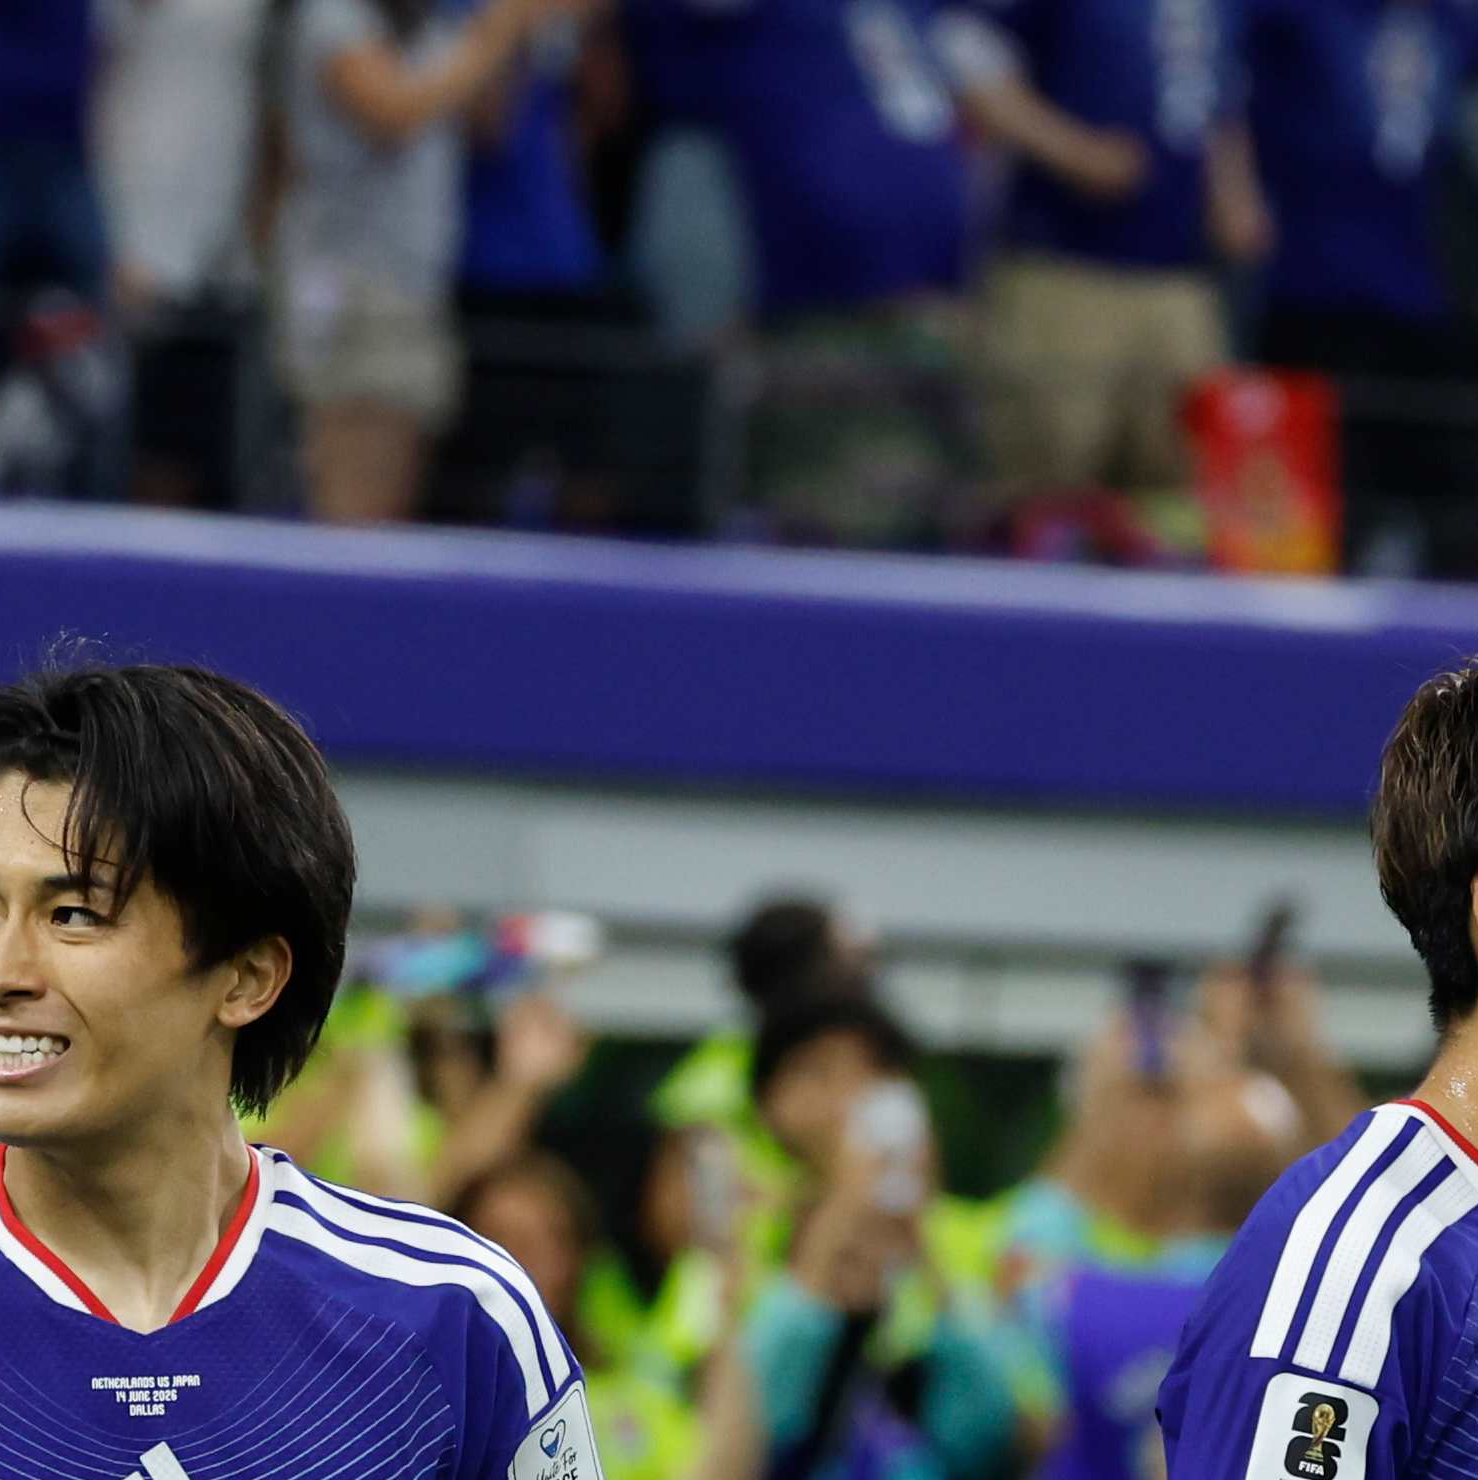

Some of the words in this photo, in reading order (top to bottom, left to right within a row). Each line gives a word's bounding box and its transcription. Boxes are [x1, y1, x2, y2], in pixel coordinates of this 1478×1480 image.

[91, 1377, 155, 1390] NETHERLANDS
[172, 1374, 200, 1387] JAPAN
[116, 1390, 126, 1402] 14
[128, 1390, 151, 1402] JUNE
[152, 1389, 177, 1402] 2026
[129, 1404, 165, 1416] DALLAS
[561, 1447, 578, 1469] For
[1298, 1461, 1325, 1476] FIFA
